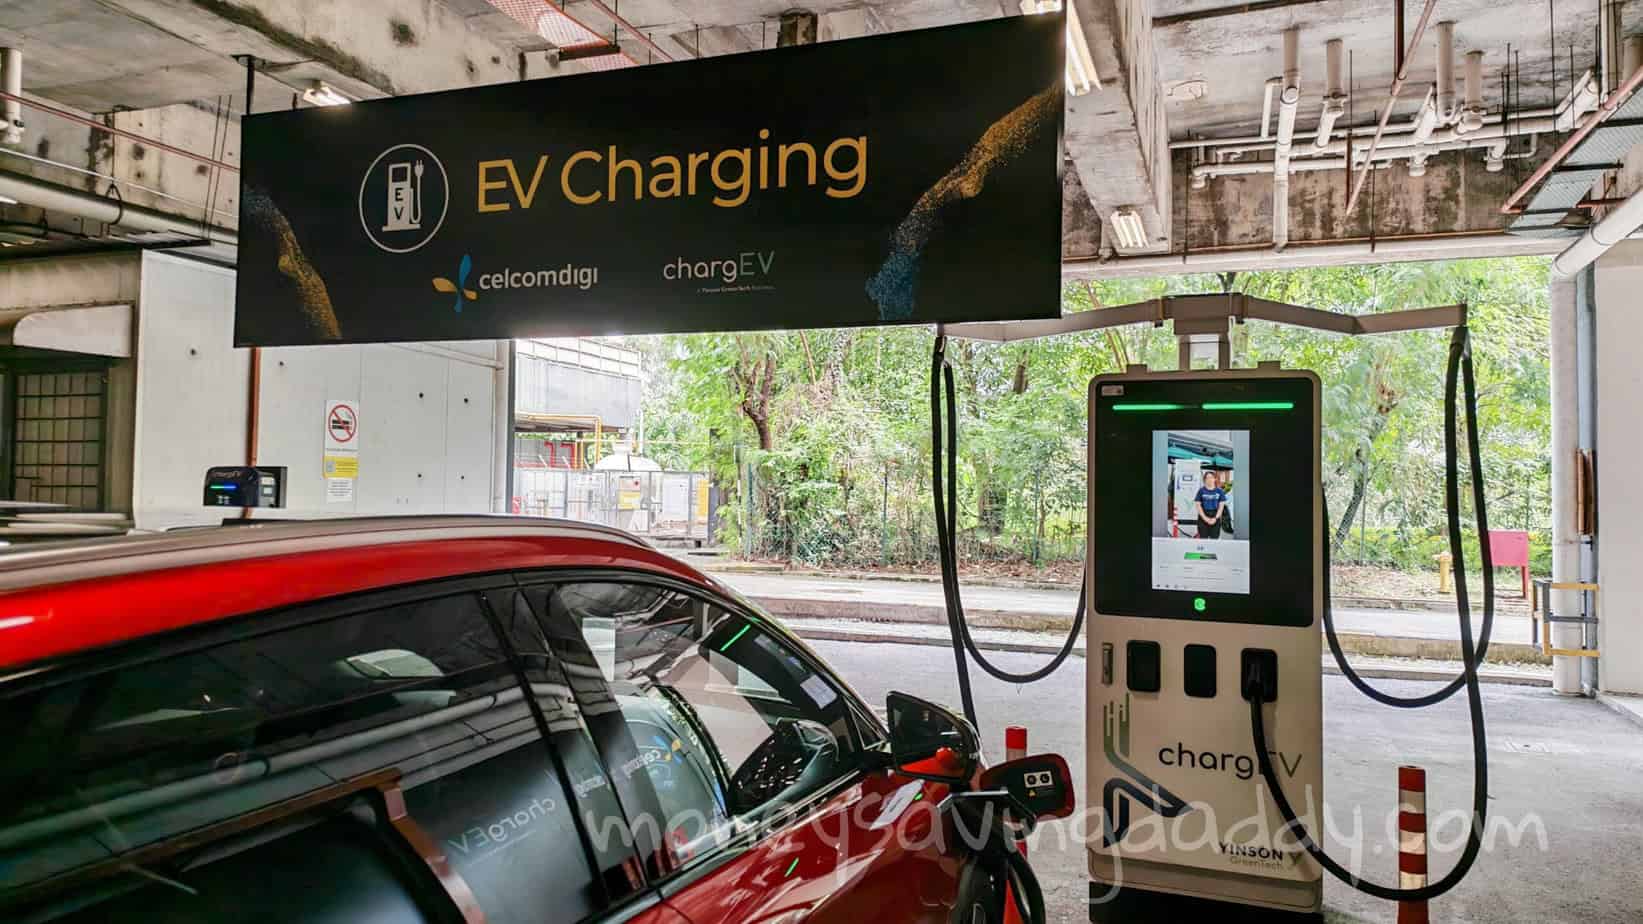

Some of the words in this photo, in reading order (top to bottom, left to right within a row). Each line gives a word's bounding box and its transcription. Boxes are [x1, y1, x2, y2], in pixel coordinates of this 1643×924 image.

[477, 155, 549, 212] EV
[560, 128, 868, 207] Charging
[479, 263, 598, 290] celcomdigi
[663, 250, 775, 283] chargEV
[1158, 741, 1303, 780] chargV
[1219, 841, 1283, 861] YINSON
